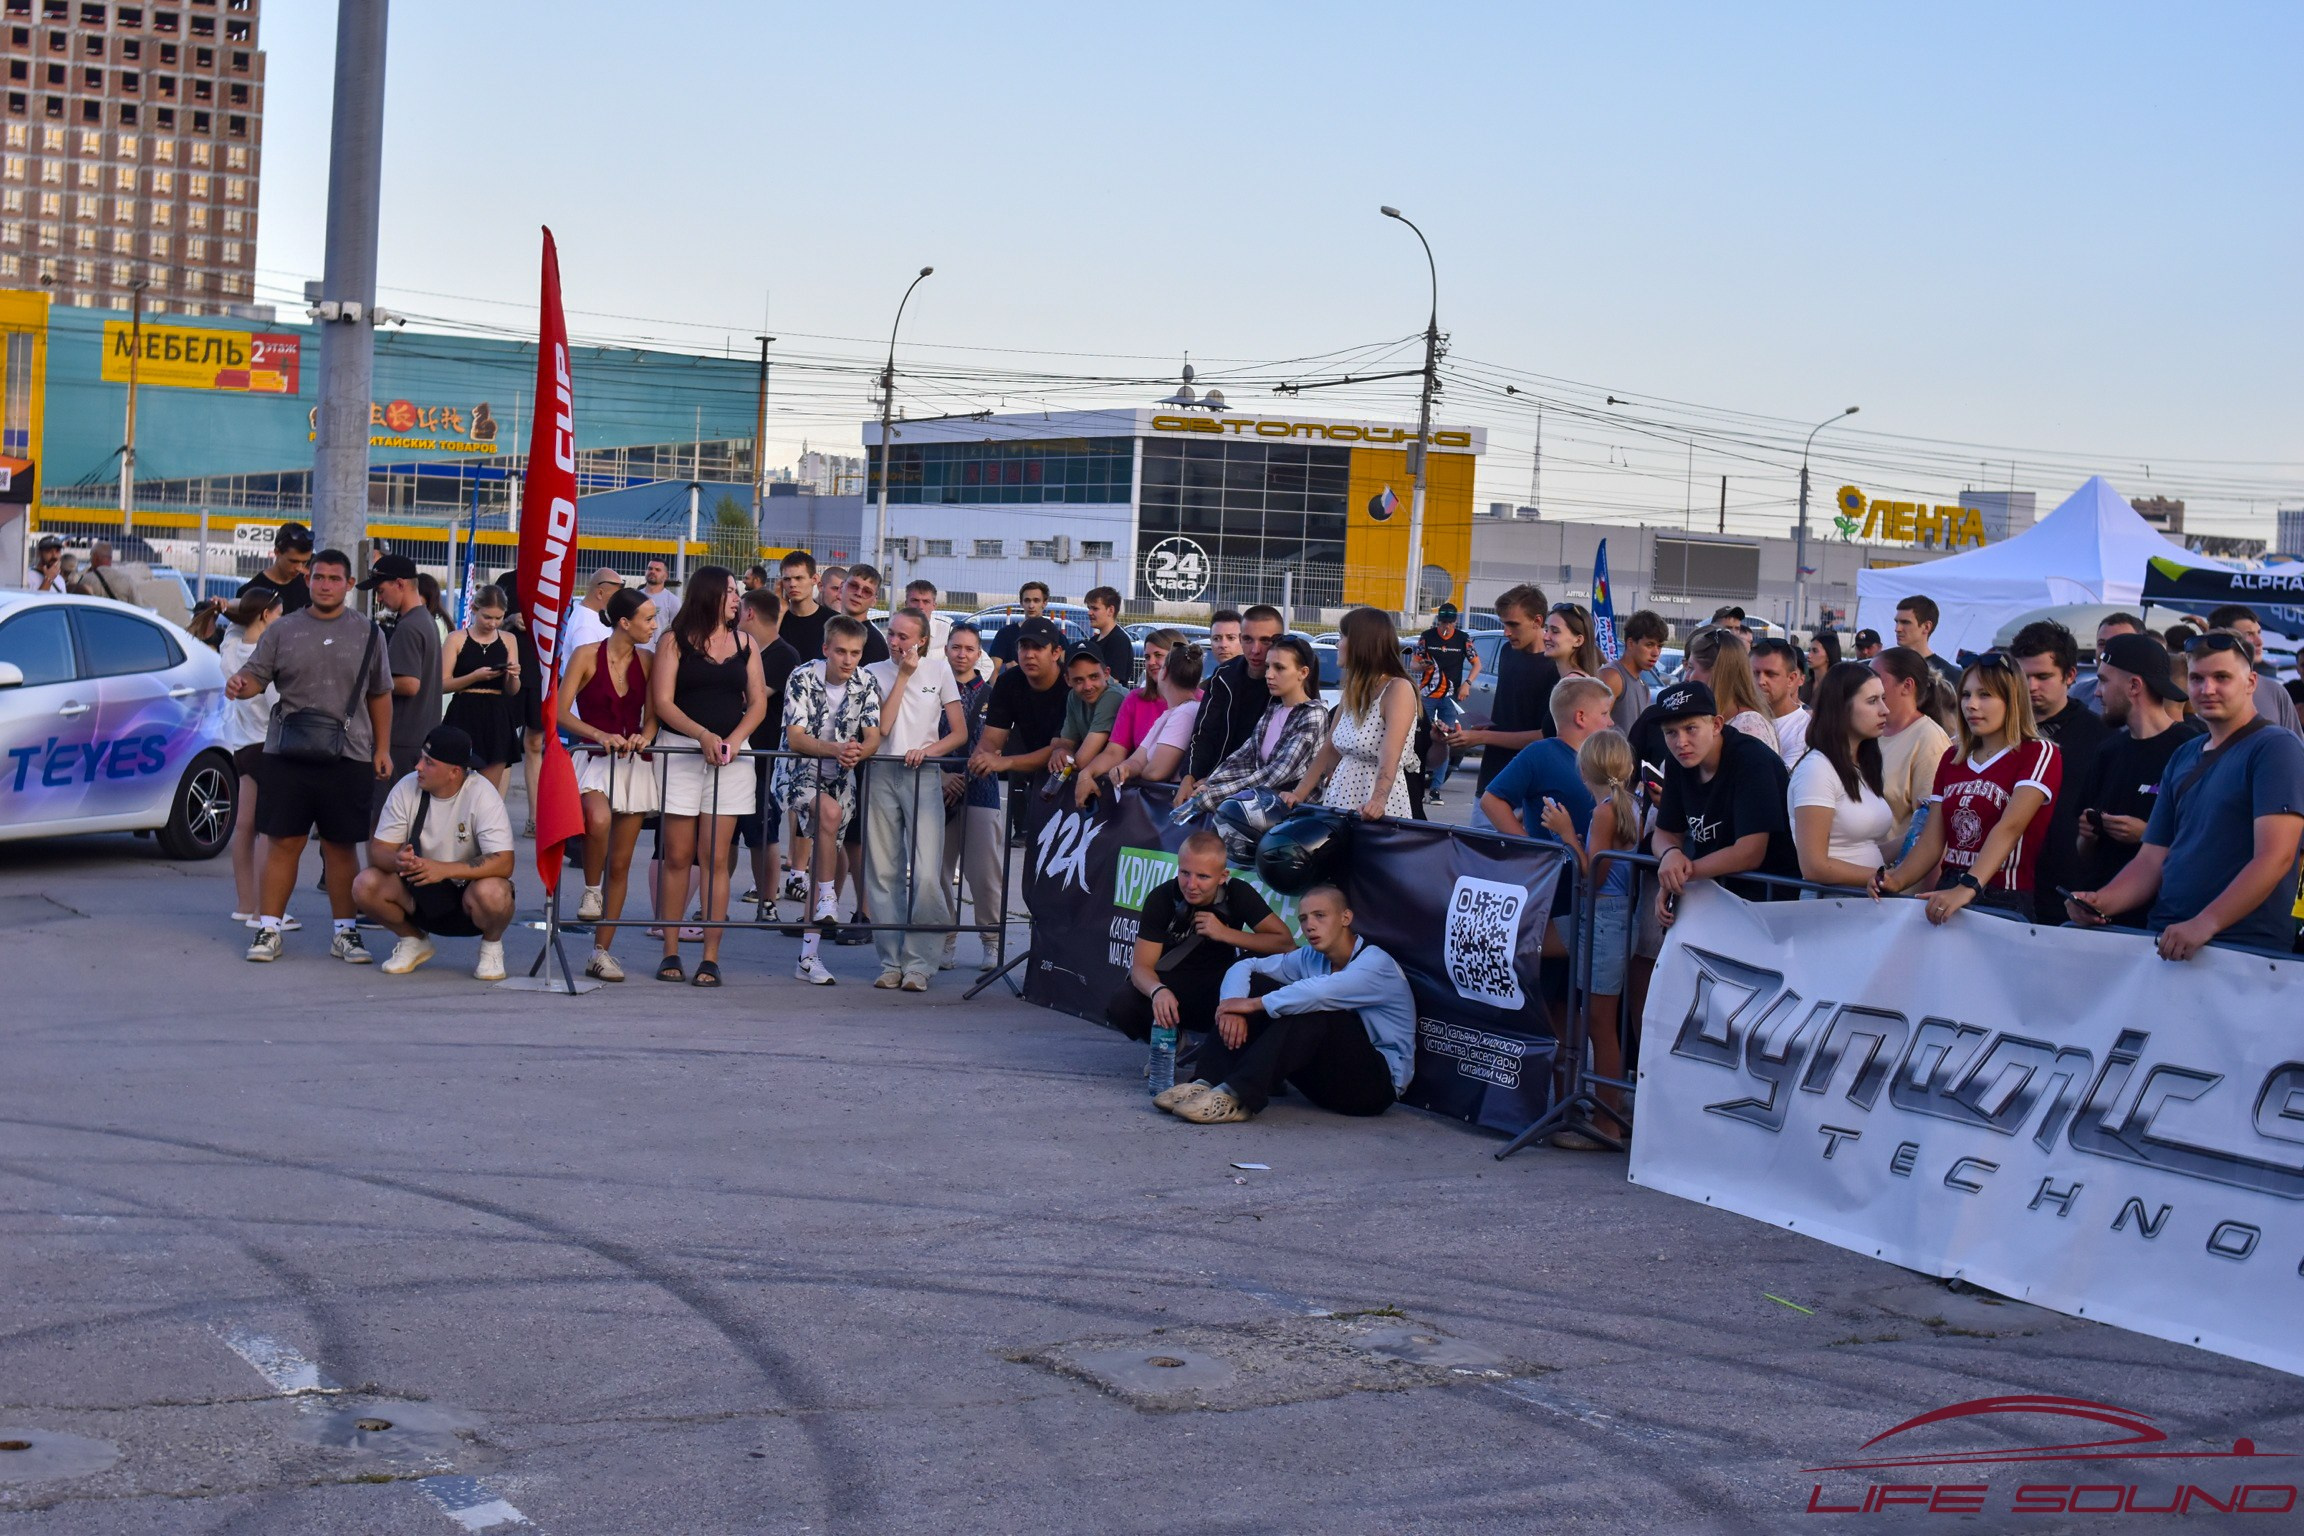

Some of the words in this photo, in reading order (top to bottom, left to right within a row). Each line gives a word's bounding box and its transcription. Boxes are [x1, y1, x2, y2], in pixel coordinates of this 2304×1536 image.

[114, 330, 244, 366] МЕБЕЛЬ
[251, 340, 266, 363] 2
[555, 342, 575, 474] CUP
[368, 436, 436, 450] ИТАЙСКИХ
[440, 441, 498, 454] ТОВАРОВ
[1861, 499, 1986, 547] ЛЕНТА
[1156, 551, 1201, 579] 24
[1156, 579, 1198, 590] часа
[1566, 590, 1590, 599] АПТЕКА
[2230, 574, 2304, 591] ALPHA
[1959, 795, 1974, 807] OF
[1108, 941, 1135, 969] МАГАЗ
[1420, 1019, 1444, 1036] табаки
[1447, 1027, 1478, 1043] кальяны
[1480, 1036, 1523, 1055] жидкости
[1426, 1038, 1466, 1057] устройства
[1470, 1048, 1517, 1069] аксессуары
[1460, 1061, 1495, 1079] китайский
[1495, 1070, 1516, 1086] чай
[1818, 1123, 2304, 1277] TECHNO
